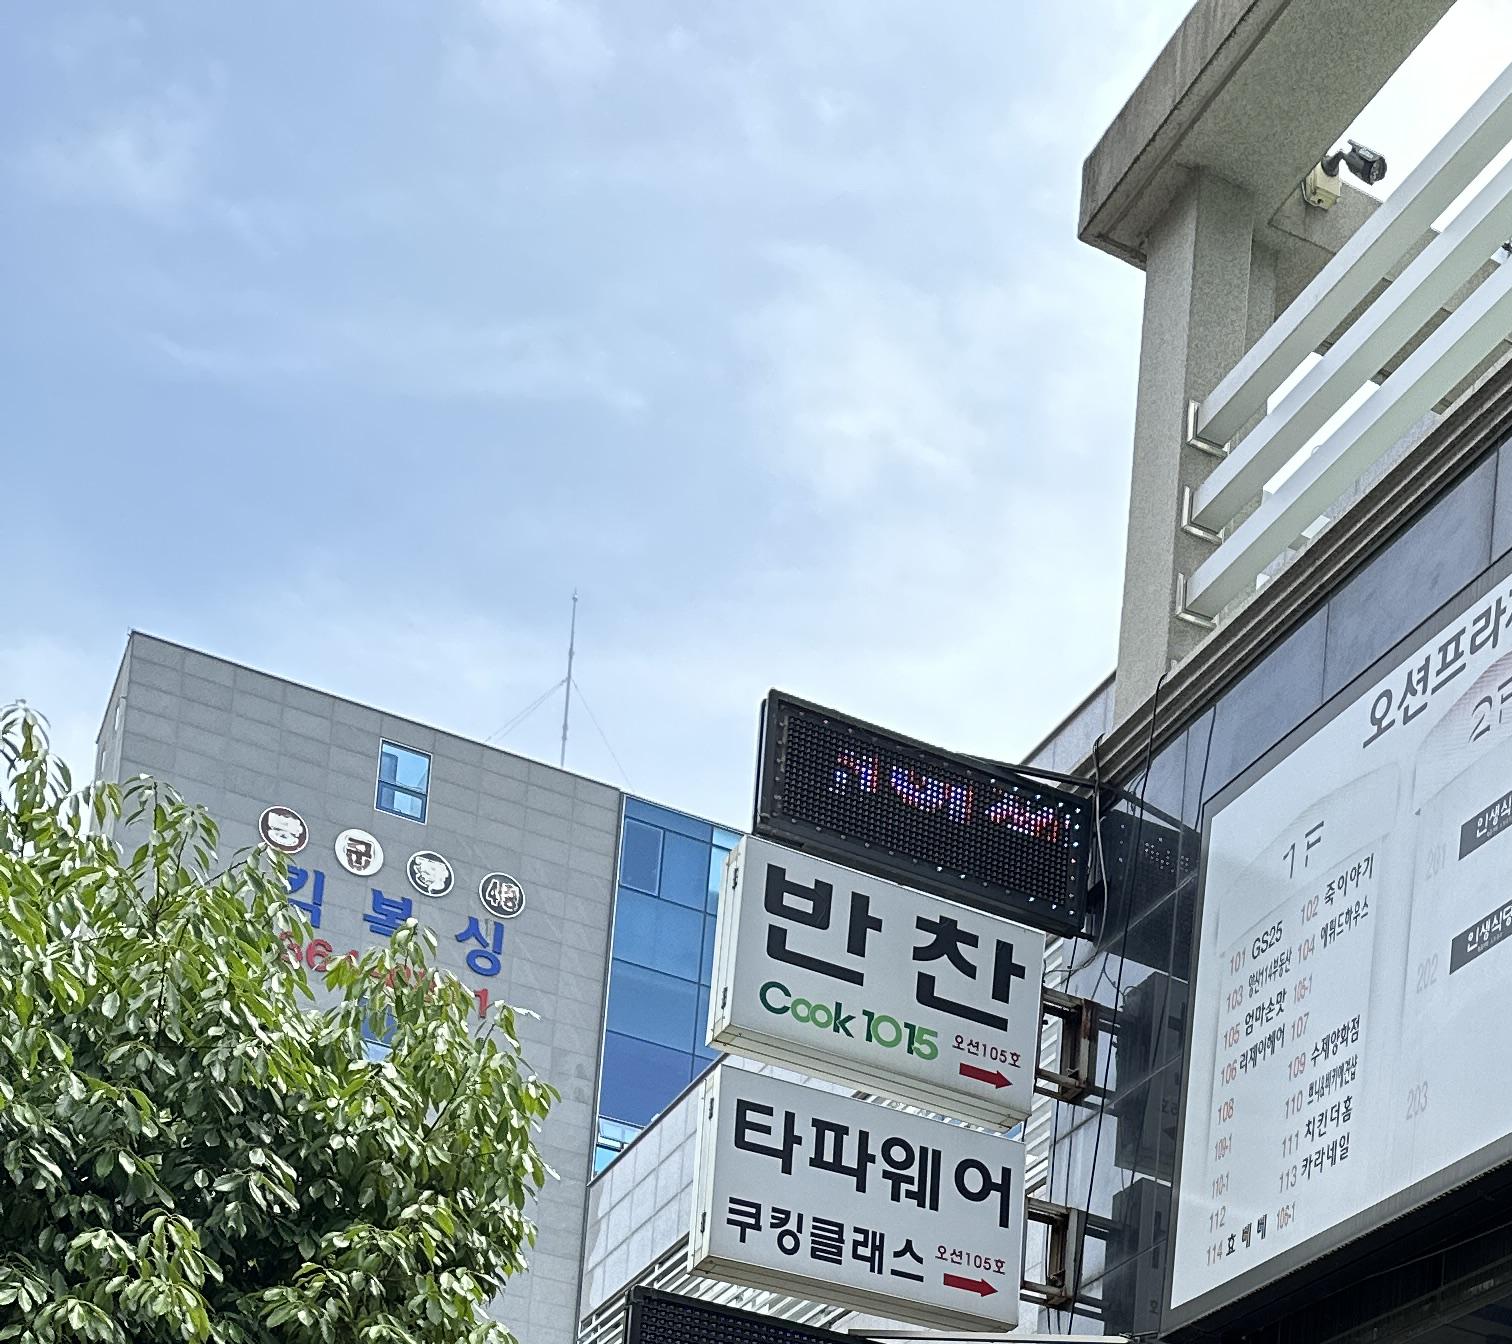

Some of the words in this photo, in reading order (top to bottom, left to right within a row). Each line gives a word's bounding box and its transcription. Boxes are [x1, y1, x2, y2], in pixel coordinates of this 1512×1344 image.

[1301, 895, 1319, 925] 102
[1324, 853, 1374, 905] 죽이야기
[1230, 947, 1246, 976] 101
[1251, 920, 1283, 960] GS25
[1298, 934, 1315, 964] 104
[1417, 953, 1438, 994] 202
[1224, 1023, 1240, 1050] 105
[1244, 988, 1287, 1036] 엄마손맛
[1227, 985, 1243, 1013] 103
[759, 980, 856, 1041] Cook
[862, 1008, 939, 1061] 1015
[1291, 1012, 1309, 1041] 107
[952, 1034, 1022, 1069] 오션105호
[1288, 1052, 1306, 1081] 109
[1311, 1014, 1361, 1067] 수제양화점
[1221, 1059, 1237, 1087] 106
[1218, 1098, 1235, 1125] 108
[1285, 1090, 1303, 1119] 110
[1405, 1080, 1429, 1121] 203
[1282, 1130, 1299, 1158] 111
[1305, 1095, 1353, 1142] 치킨더홈
[733, 1098, 1013, 1230] 타파웨어
[1279, 1164, 1297, 1193] 113
[1301, 1132, 1350, 1180] 카라네일
[726, 1196, 925, 1283] 쿠킹클래스
[1209, 1206, 1226, 1233] 112
[934, 1244, 1006, 1276] 오션105호
[1207, 1240, 1223, 1266] 114
